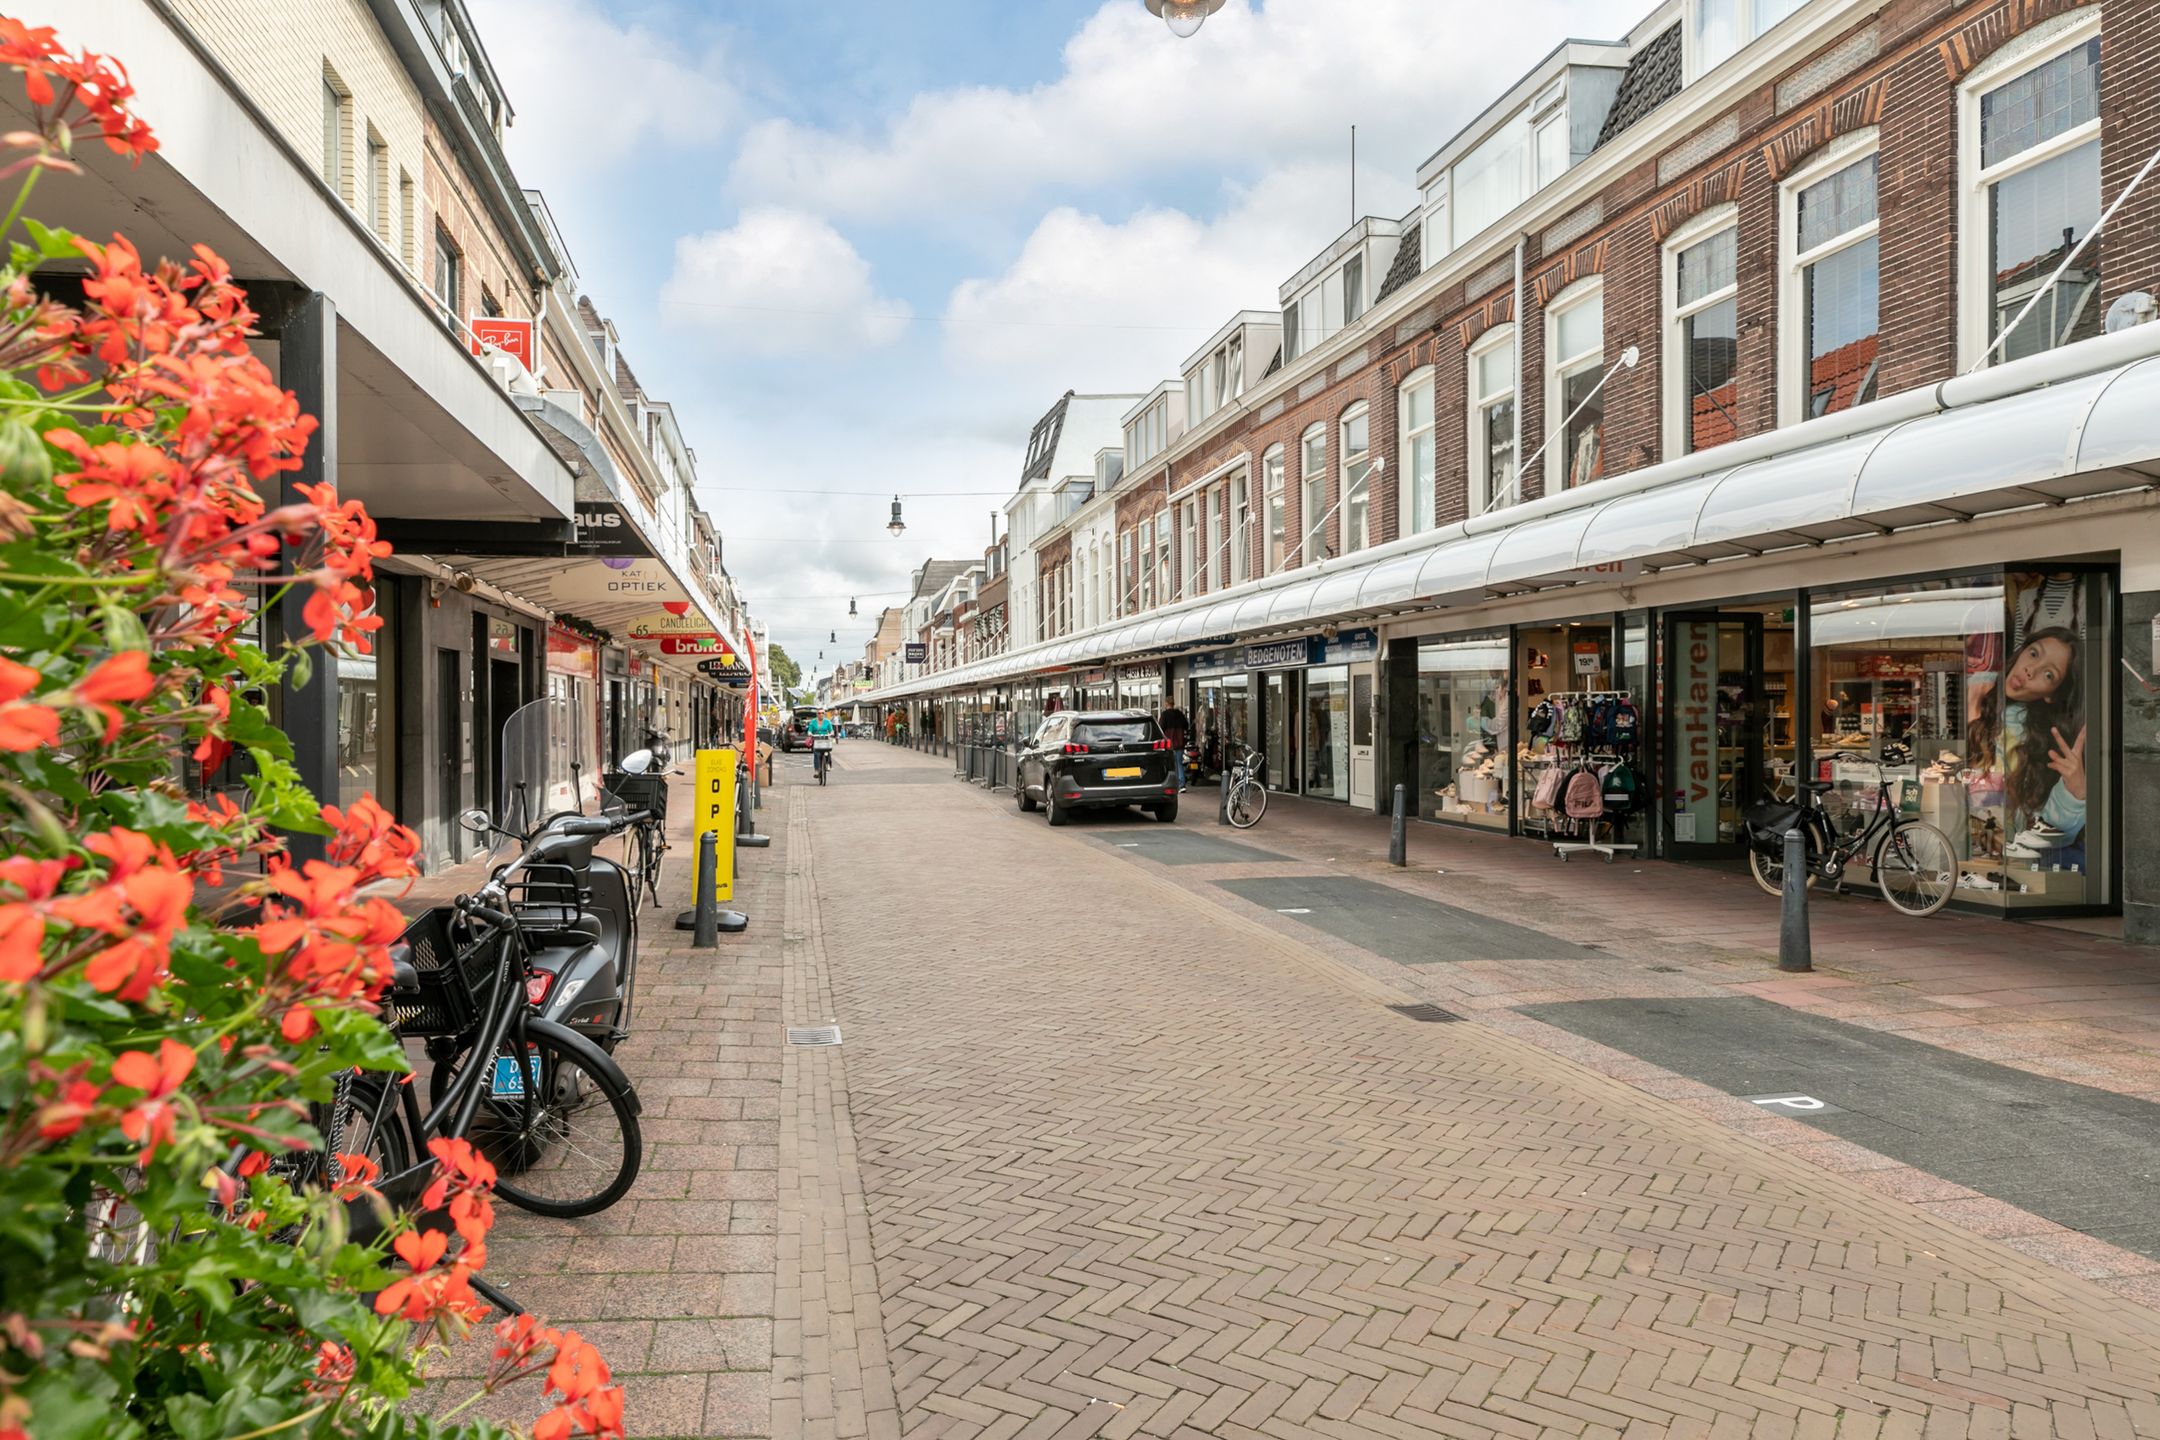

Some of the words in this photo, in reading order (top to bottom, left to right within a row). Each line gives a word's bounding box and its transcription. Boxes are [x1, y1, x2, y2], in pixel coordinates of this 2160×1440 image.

[608, 581, 667, 591] OPTIEK
[635, 625, 648, 636] 65
[1247, 642, 1303, 665] BEDGENOTEN
[1686, 622, 1710, 803] vanHaren
[1751, 1096, 1825, 1110] P
